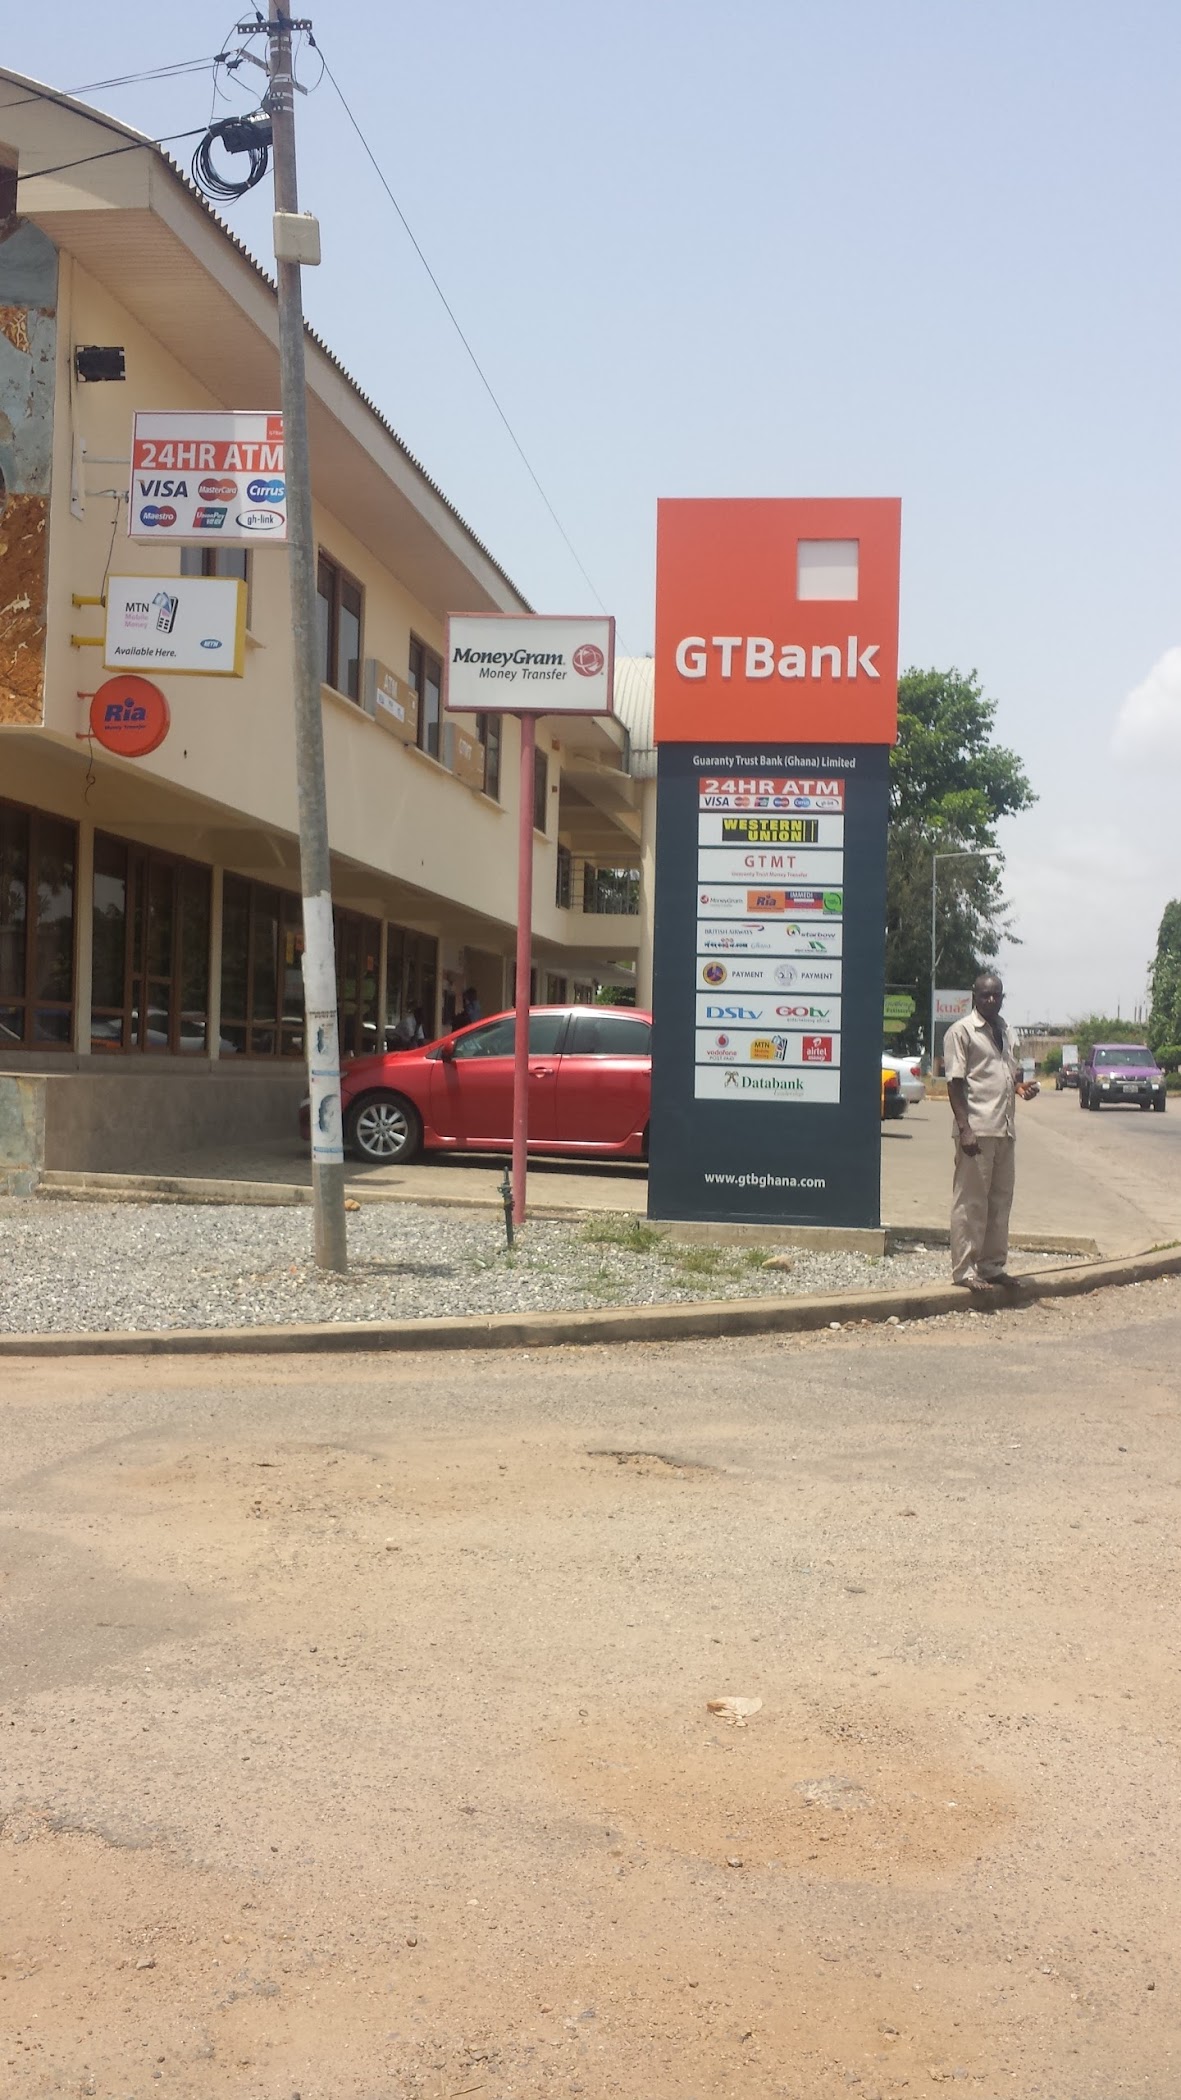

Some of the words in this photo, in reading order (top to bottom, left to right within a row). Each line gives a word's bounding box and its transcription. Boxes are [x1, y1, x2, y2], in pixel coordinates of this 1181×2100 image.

[141, 443, 216, 470] 24HR
[223, 444, 284, 470] ATM
[136, 479, 188, 498] VISA
[199, 485, 237, 495] MasterCard
[249, 485, 285, 496] Cirrus
[143, 512, 174, 521] Maestro
[196, 511, 226, 520] UnionPay
[247, 513, 274, 525] gh-link
[125, 602, 149, 612] MTN
[125, 613, 149, 621] Mobile
[125, 621, 148, 629] Money
[203, 640, 219, 648] MTN
[114, 646, 153, 656] Available
[155, 648, 177, 657] Here.
[675, 635, 881, 679] GTBank
[479, 667, 517, 681] Money
[522, 668, 567, 680] Transfer
[104, 697, 146, 722] Ria
[693, 755, 734, 768] Guaranty
[735, 756, 758, 766] Trust
[760, 755, 783, 766] Bank
[784, 756, 820, 769] (Ghana)
[821, 756, 856, 769] Limited
[705, 780, 775, 794] 24HR
[782, 780, 838, 795] ATM
[704, 796, 730, 807] VISA
[723, 819, 802, 830] WESTERN
[748, 830, 802, 841] UNION
[756, 894, 777, 906] Ria
[706, 1006, 763, 1020] DStv
[776, 1006, 830, 1018] GOtv
[806, 1046, 827, 1056] airtel
[742, 1076, 804, 1090] Databank
[704, 1173, 826, 1188] www.gtbghana.com
